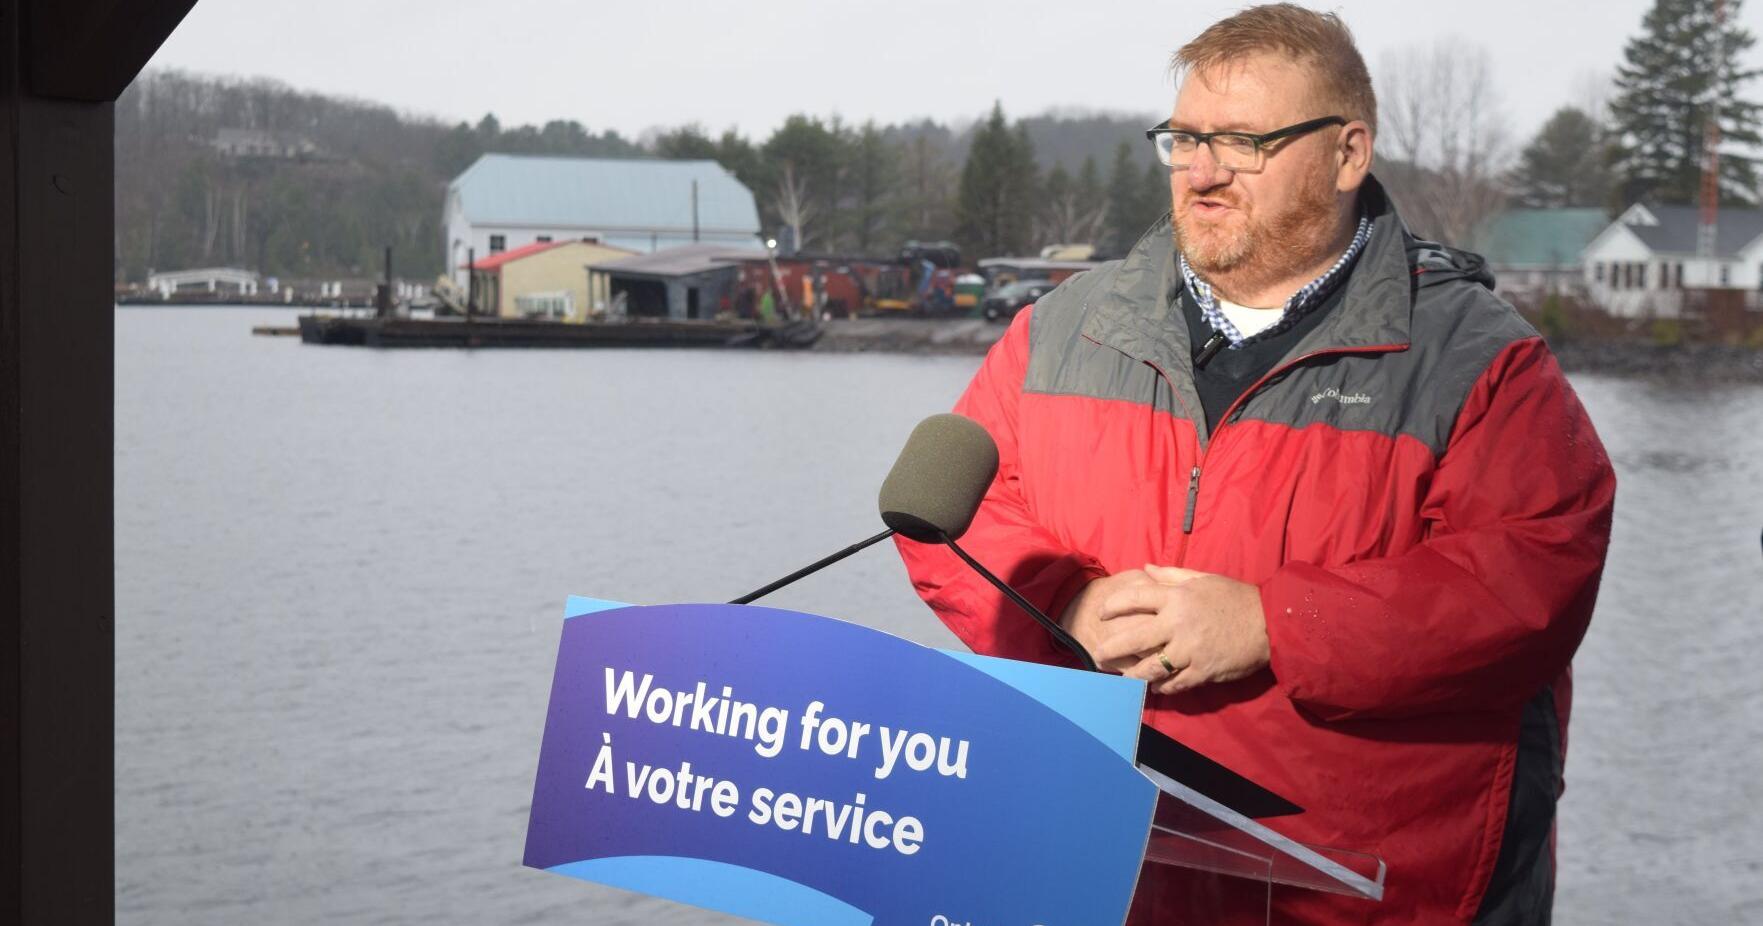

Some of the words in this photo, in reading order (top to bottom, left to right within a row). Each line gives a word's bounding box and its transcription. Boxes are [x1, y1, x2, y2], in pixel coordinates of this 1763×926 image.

[604, 667, 789, 758] Working
[800, 700, 871, 759] for
[874, 726, 970, 779] you
[584, 732, 615, 794] À
[626, 761, 739, 817] votre
[748, 787, 924, 855] service
